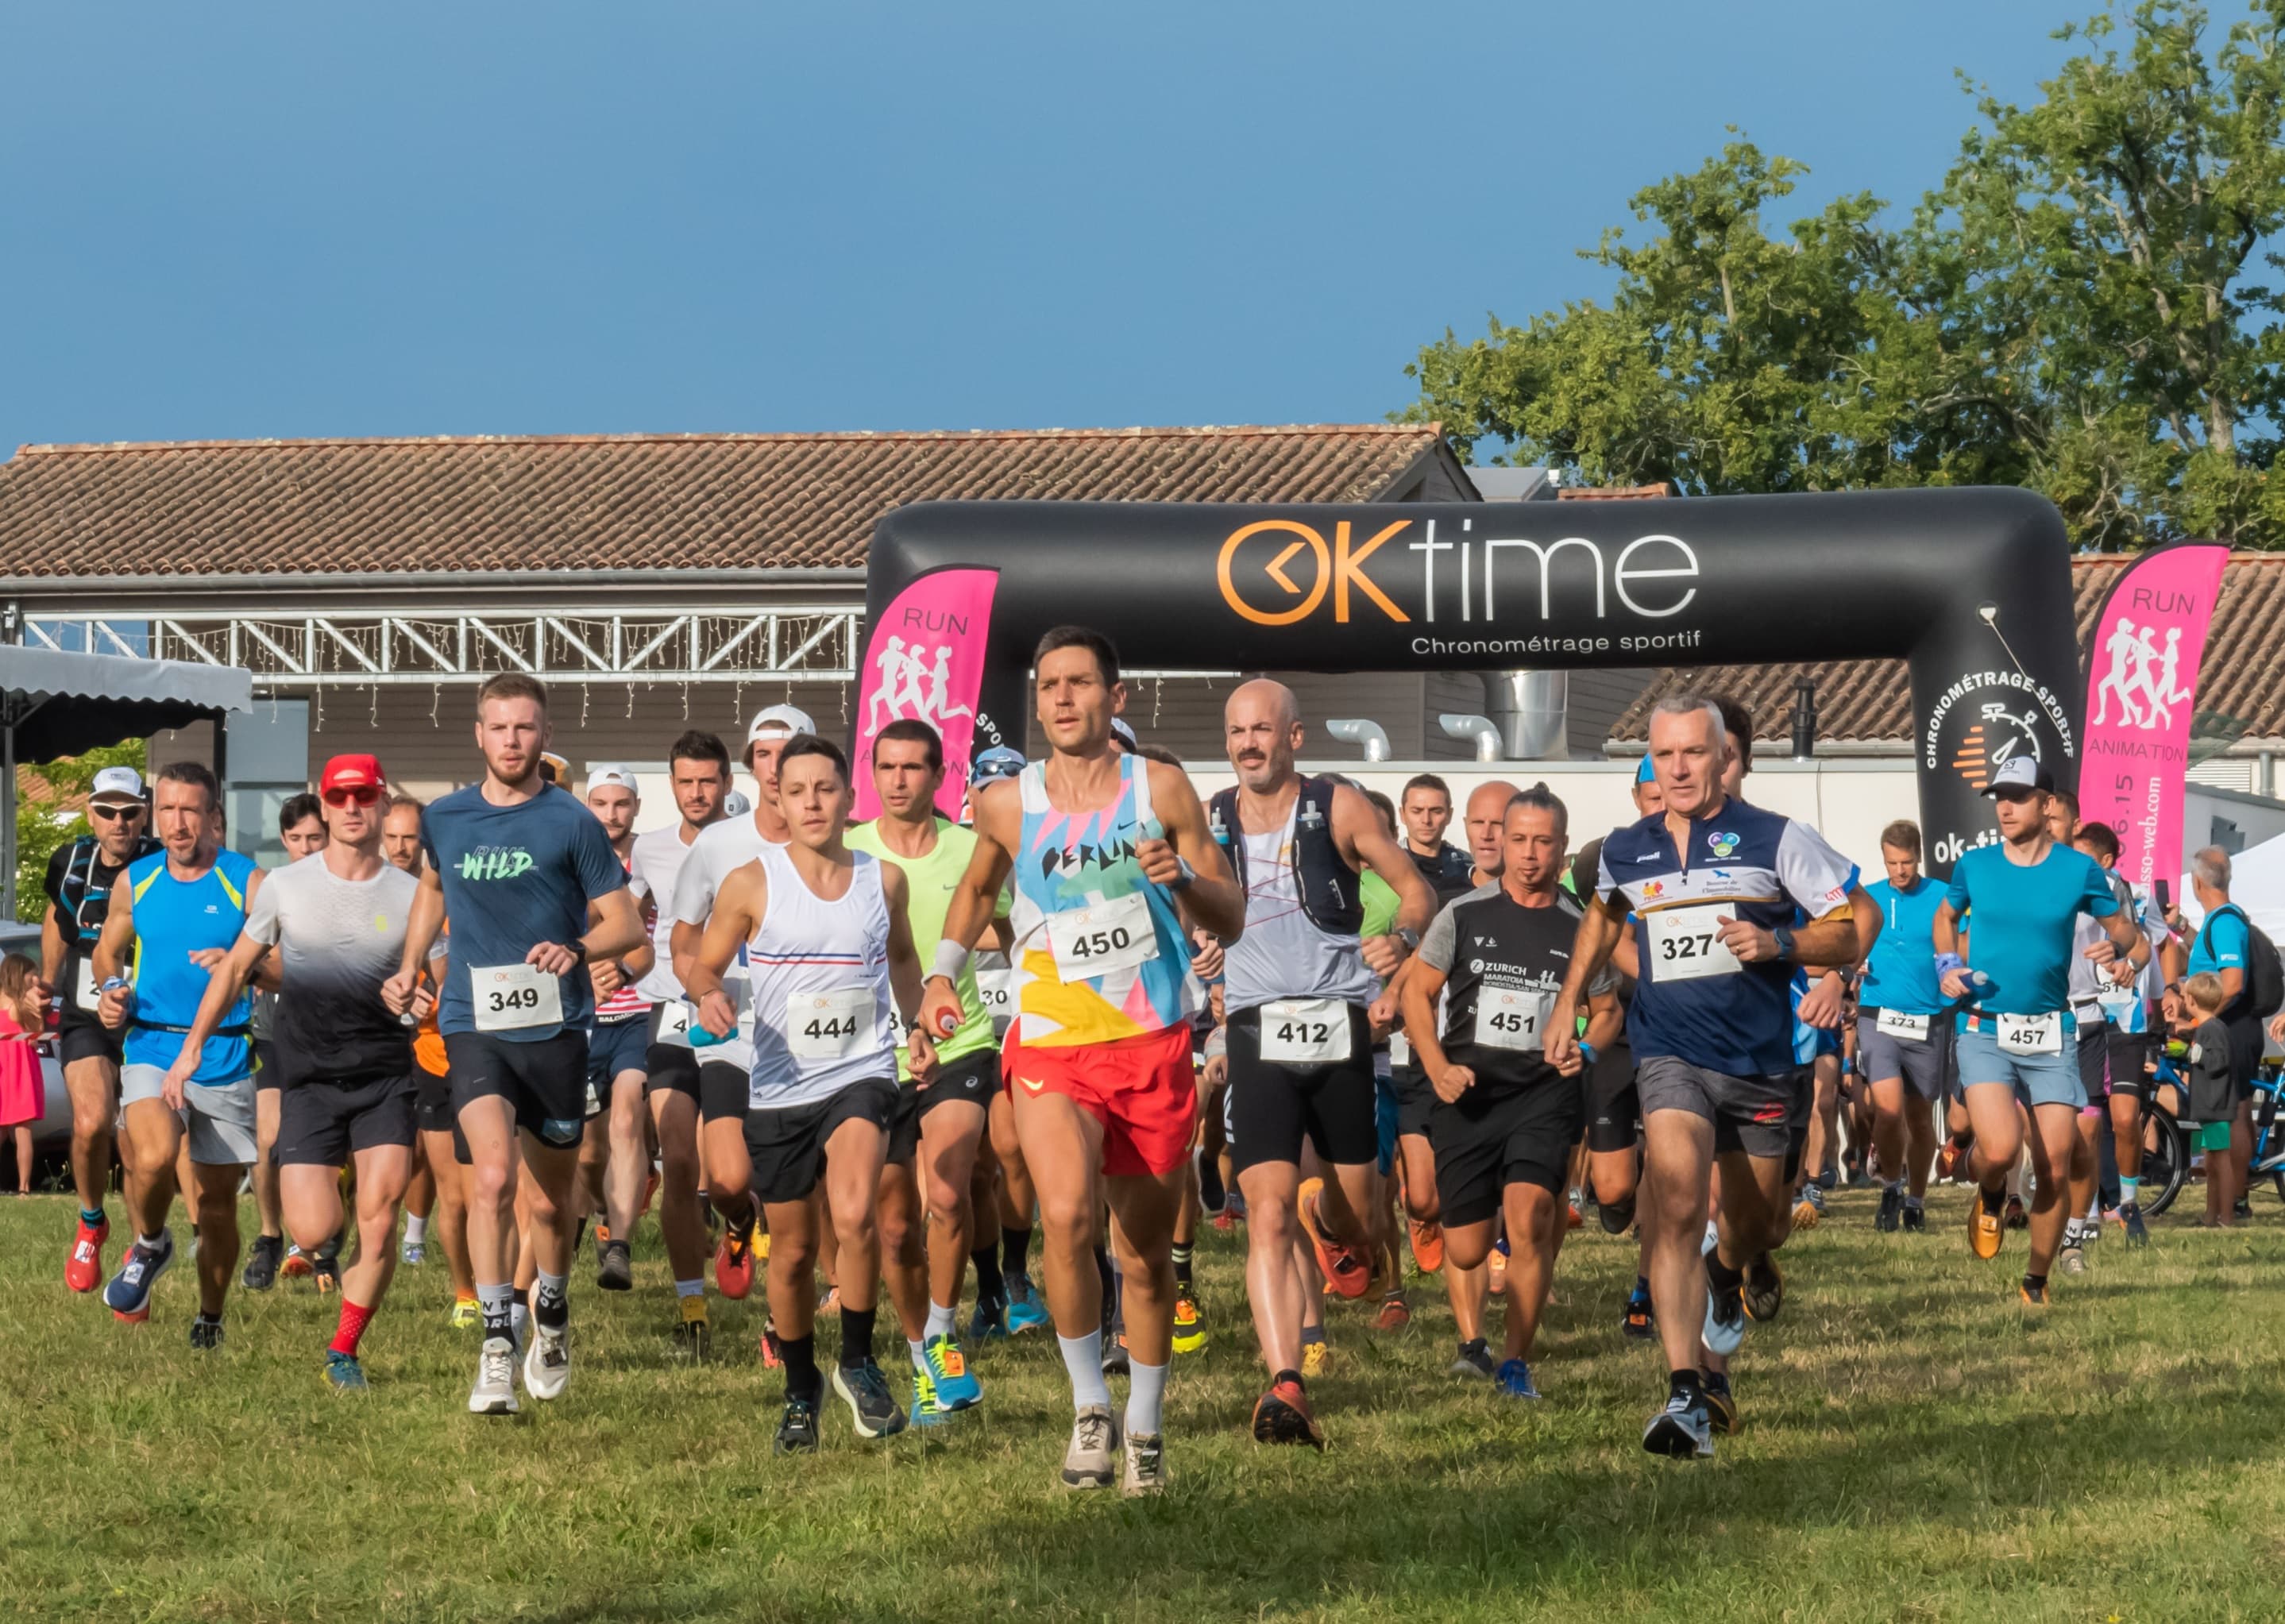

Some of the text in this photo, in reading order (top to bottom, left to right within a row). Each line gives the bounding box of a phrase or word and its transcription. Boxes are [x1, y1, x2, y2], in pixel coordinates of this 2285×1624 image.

[2133, 587, 2195, 615] RUN
[903, 608, 969, 636] RUN
[1411, 631, 1702, 655] Chronométrage sportif
[1927, 671, 2074, 769] CHRONOMÉTRAGE SPORTIF
[1935, 828, 2008, 863] ok-ti
[462, 851, 534, 881] WILD
[1041, 836, 1141, 881] BERLIN
[1072, 927, 1130, 959] 450
[1662, 933, 1713, 960] 327
[1485, 962, 1527, 976] ZURICH
[489, 988, 538, 1012] 349
[982, 990, 1008, 1005] 30
[804, 1016, 857, 1039] 444
[1277, 1023, 1329, 1043] 412
[1490, 1012, 1535, 1034] 451
[1888, 1016, 1916, 1028] 373
[2010, 1030, 2045, 1045] 457
